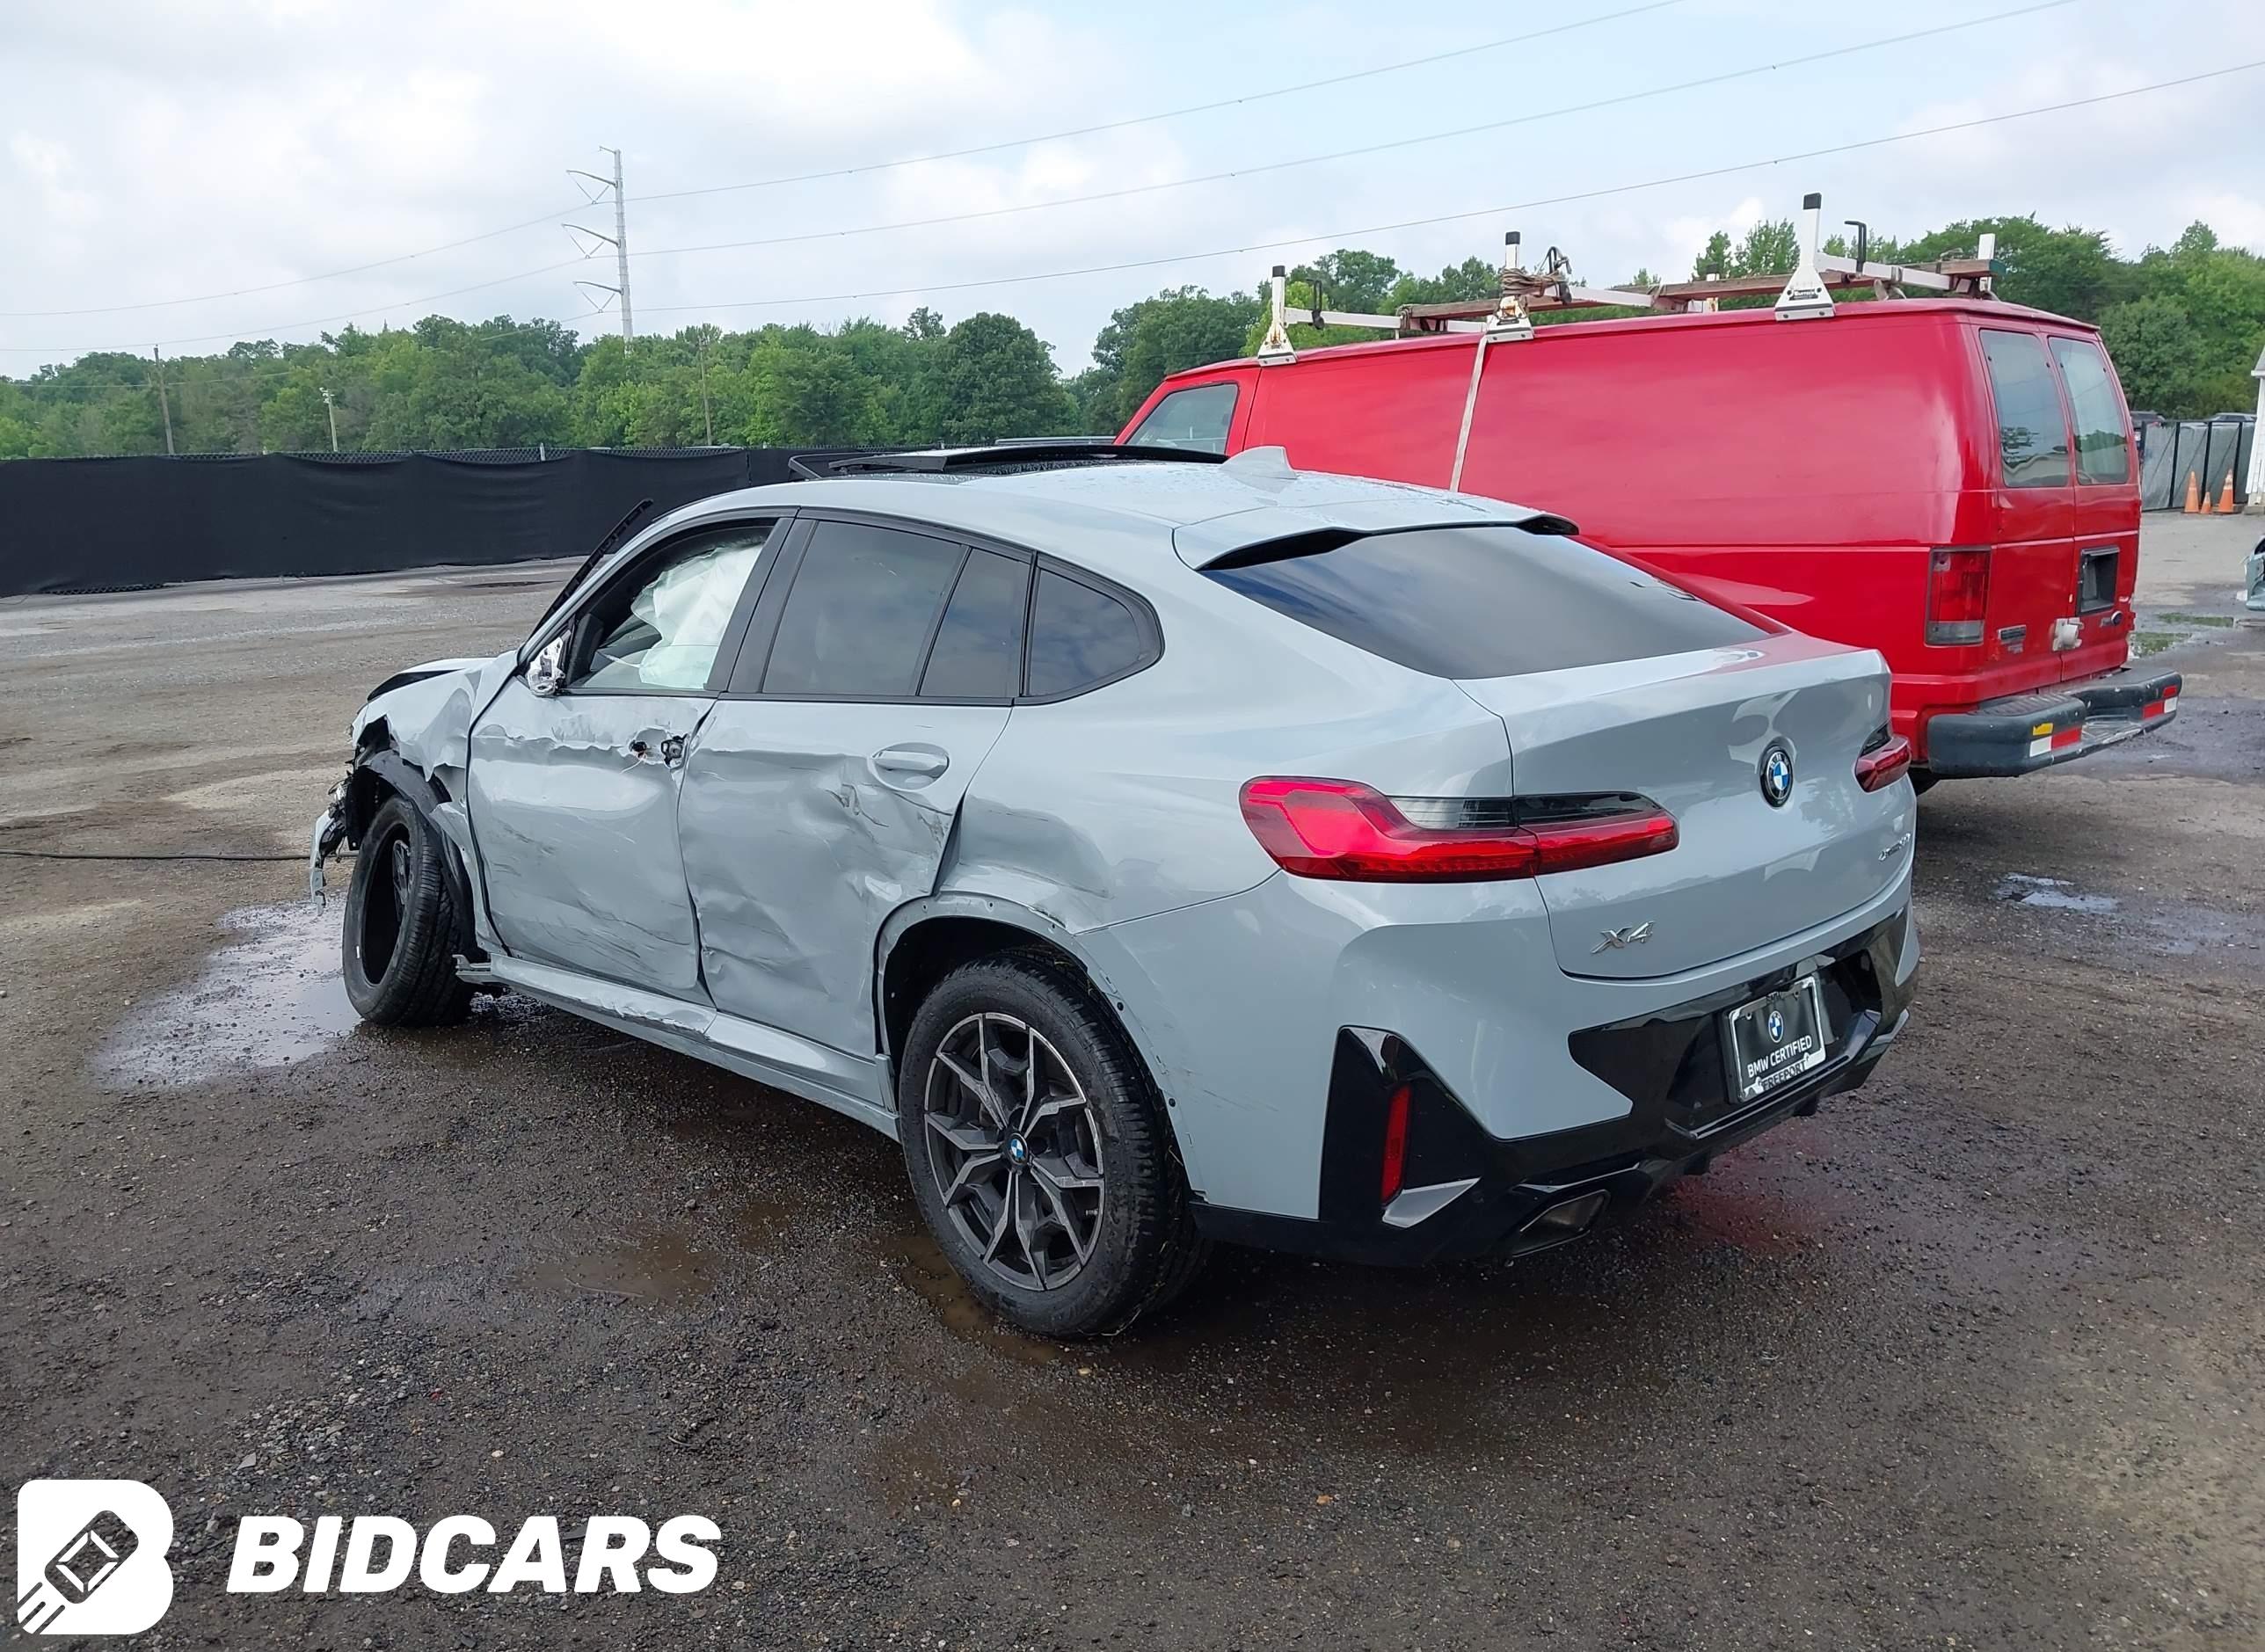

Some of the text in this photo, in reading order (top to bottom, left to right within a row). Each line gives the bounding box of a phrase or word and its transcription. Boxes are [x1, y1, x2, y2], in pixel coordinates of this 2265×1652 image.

[1591, 921, 1655, 954] X4
[1746, 1035, 1812, 1078] BMW CERTIFIED
[1760, 1060, 1808, 1091] FREEPORT
